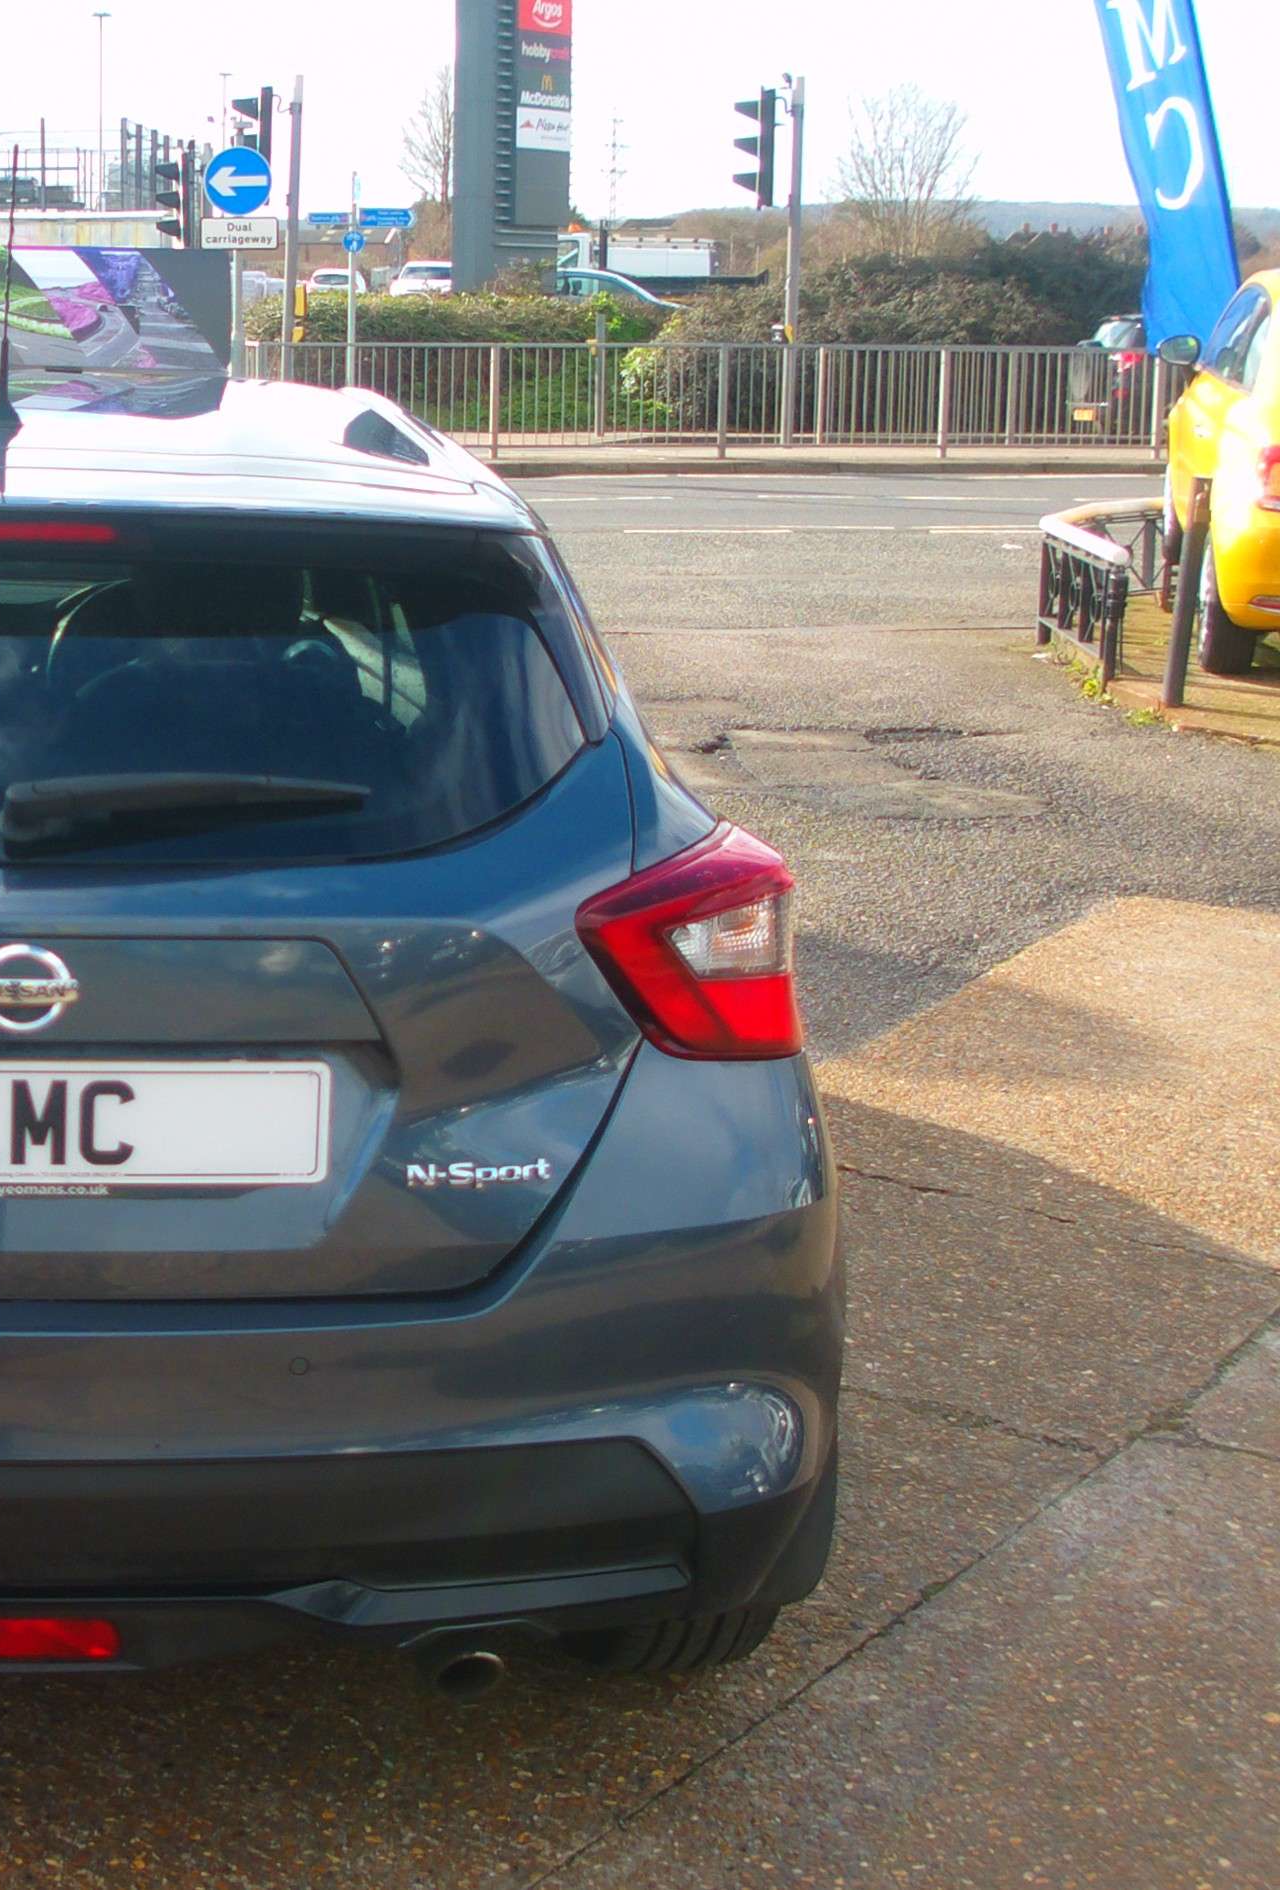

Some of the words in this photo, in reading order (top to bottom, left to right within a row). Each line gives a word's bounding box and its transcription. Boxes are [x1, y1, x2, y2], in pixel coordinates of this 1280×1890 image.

[226, 222, 252, 232] Dual
[205, 234, 272, 246] carriageway
[406, 1157, 551, 1189] N-Sport
